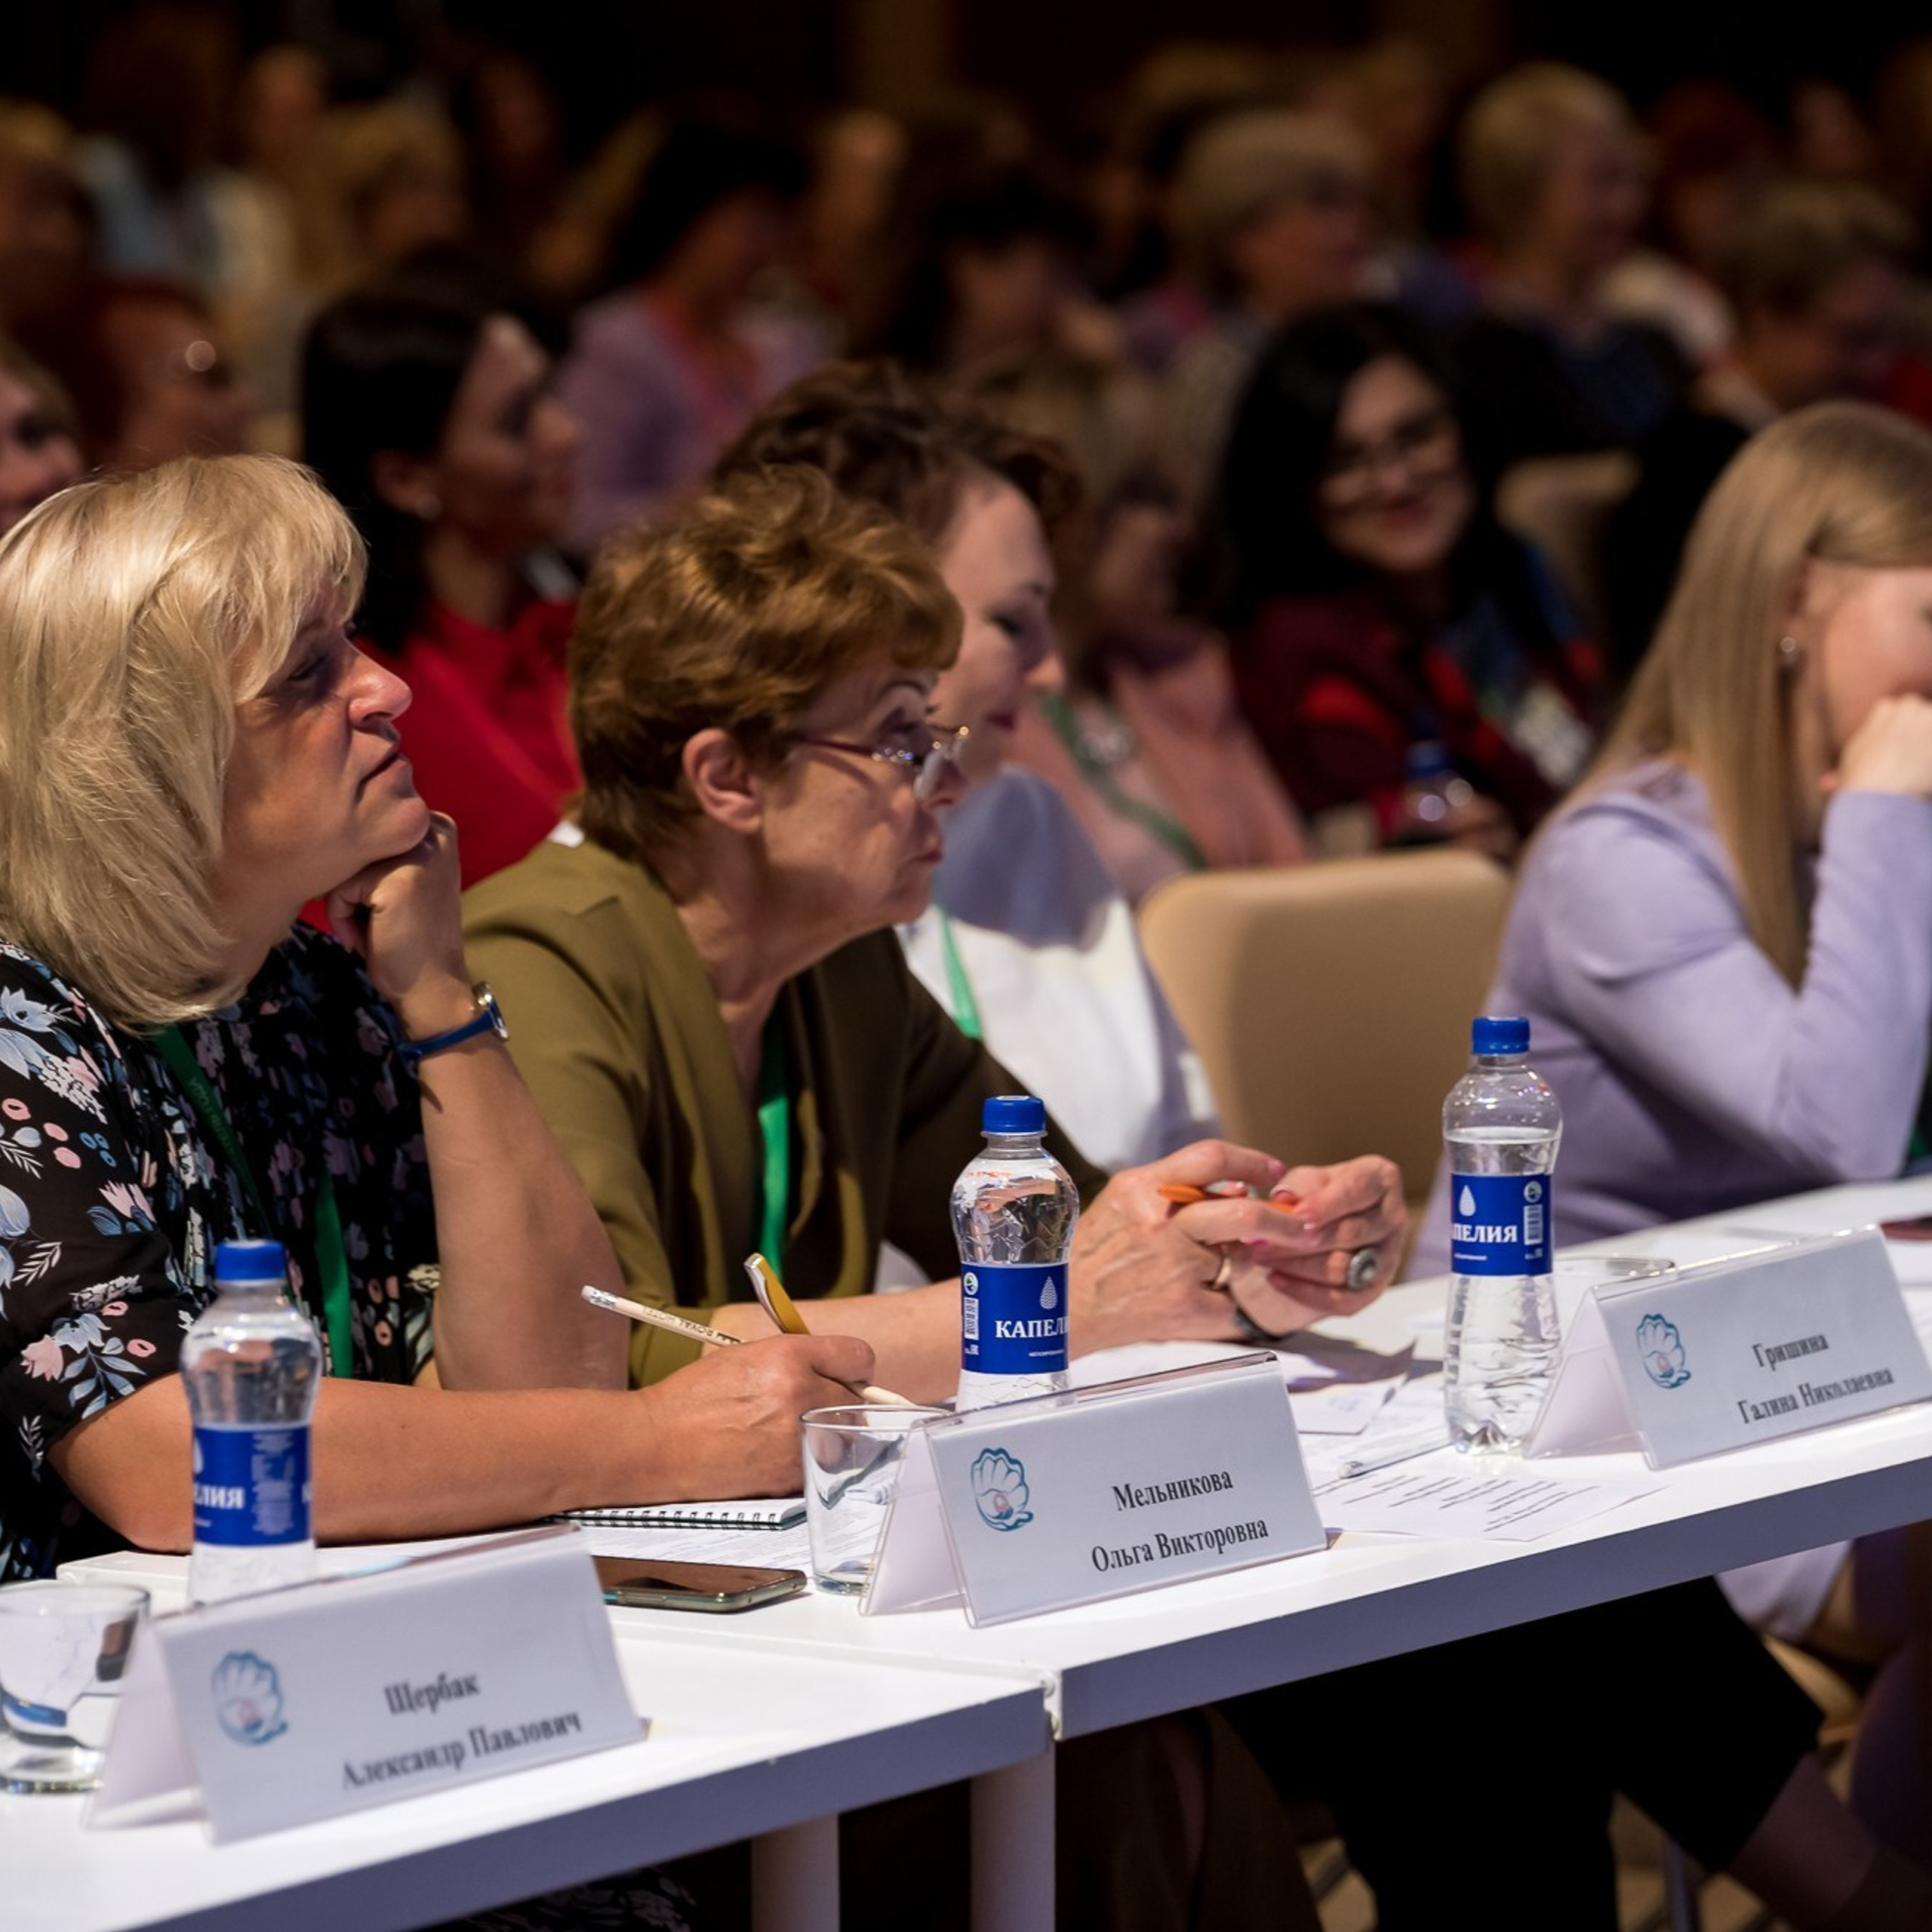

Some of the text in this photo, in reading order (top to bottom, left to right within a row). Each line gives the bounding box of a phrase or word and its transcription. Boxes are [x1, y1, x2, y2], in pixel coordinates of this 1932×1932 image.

[1452, 1223, 1518, 1243] ПЕЛИЯ
[1752, 1334, 1829, 1371] Гришина
[1737, 1367, 1894, 1424] Галина Николаевна
[1111, 1471, 1234, 1512] Мельникова
[1091, 1519, 1269, 1572] Ольга Викторовна
[384, 1672, 480, 1715] Щербак
[343, 1711, 583, 1791] Александр Павлович
